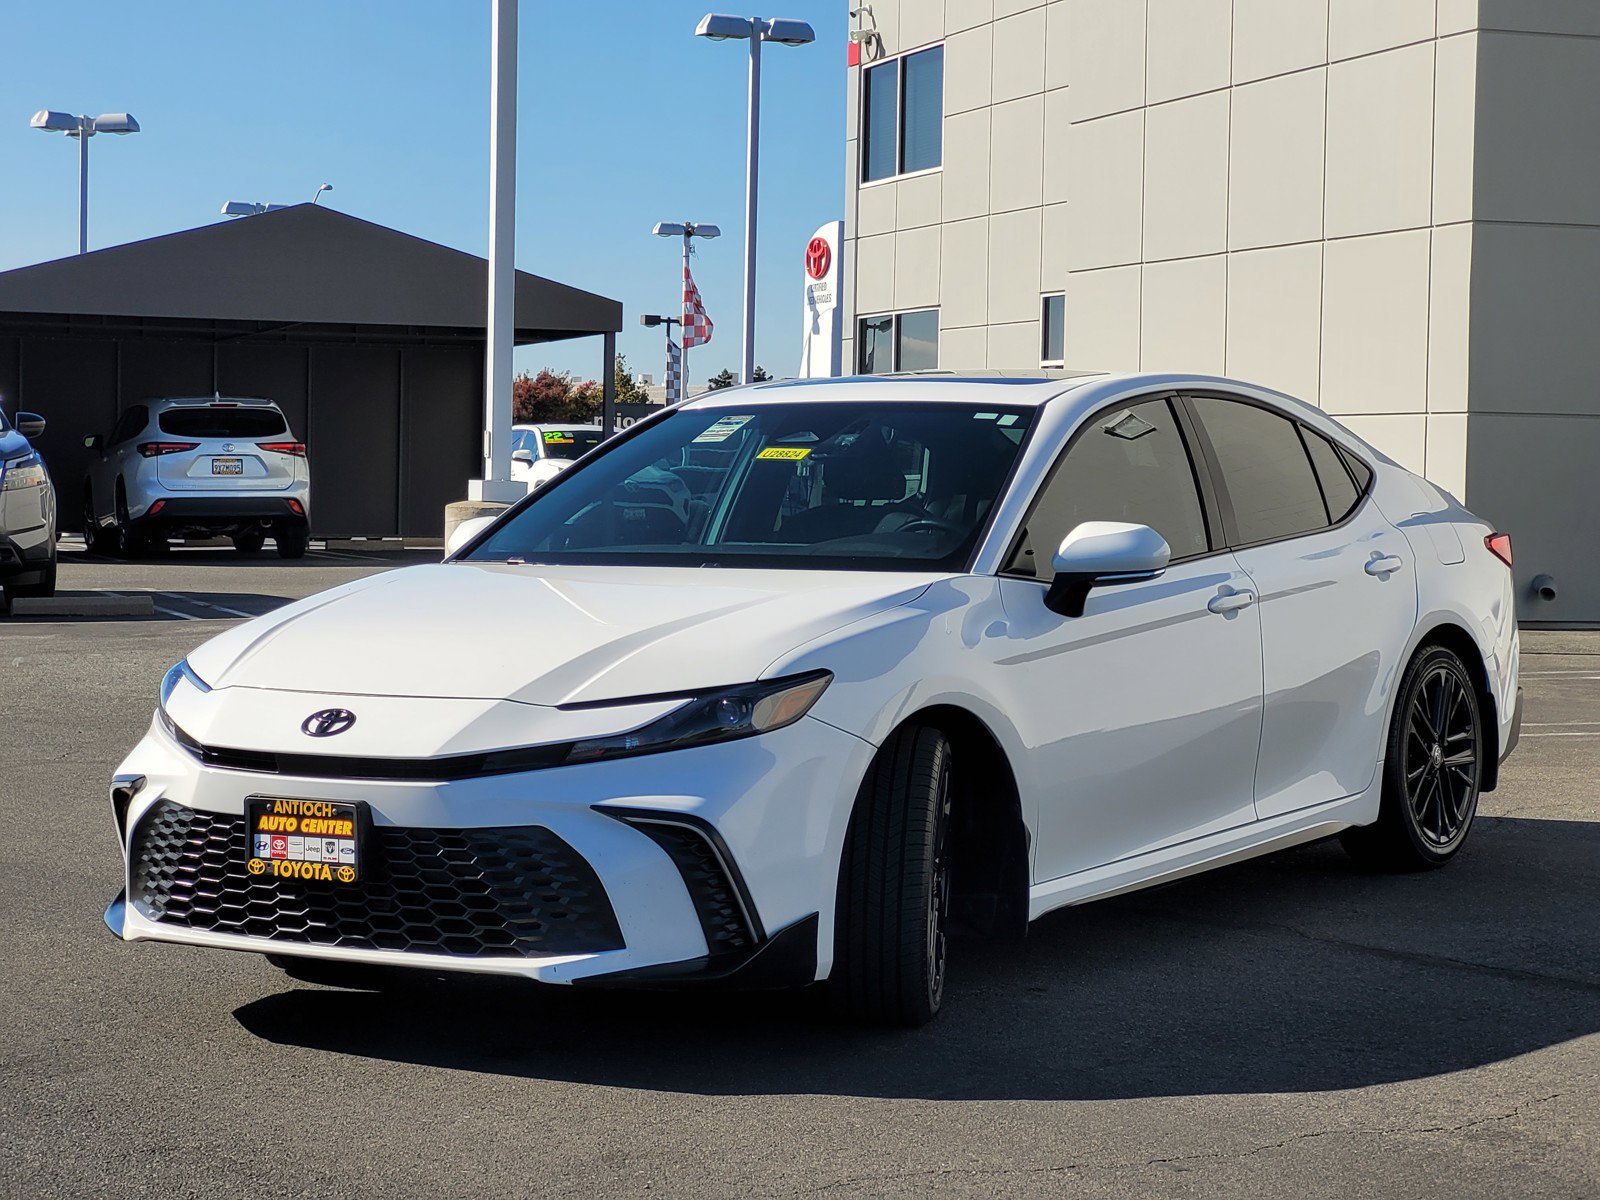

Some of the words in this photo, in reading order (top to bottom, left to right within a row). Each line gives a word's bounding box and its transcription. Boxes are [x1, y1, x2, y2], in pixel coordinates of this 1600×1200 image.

[544, 432, 563, 441] 22
[274, 800, 332, 817] ANTIOCH
[258, 815, 298, 832] AUTO
[300, 818, 353, 836] CENTER
[306, 845, 320, 854] Jeep
[272, 860, 332, 881] TOYOTA
